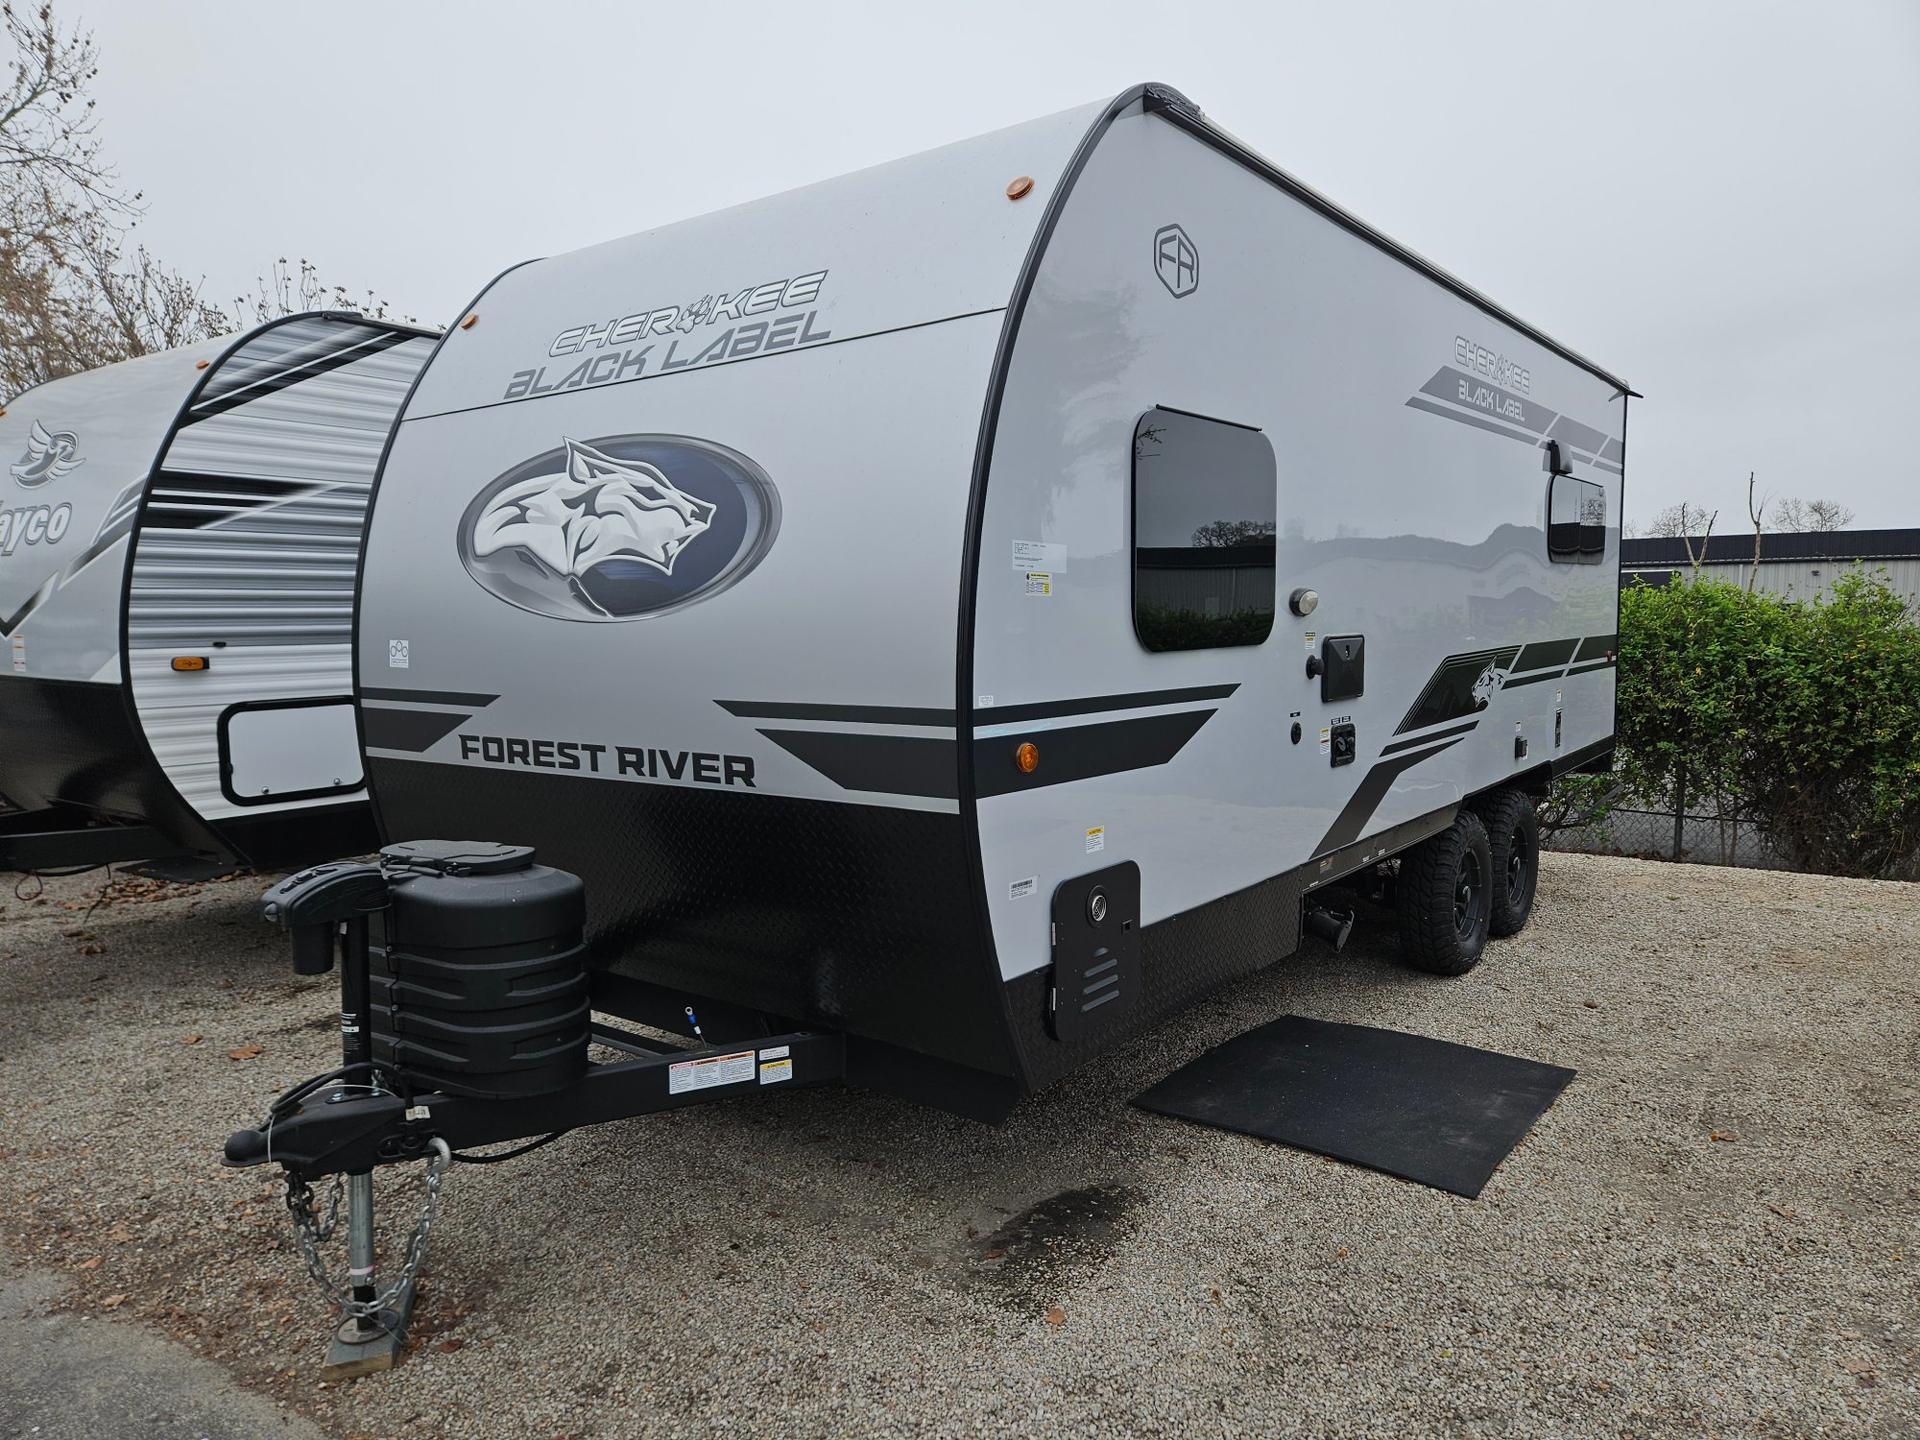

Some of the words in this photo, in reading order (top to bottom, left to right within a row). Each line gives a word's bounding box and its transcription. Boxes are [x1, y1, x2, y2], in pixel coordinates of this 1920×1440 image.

[503, 345, 655, 400] BLACK
[660, 310, 832, 371] LABEL
[1458, 379, 1495, 410] BLACK
[1496, 394, 1526, 422] LABEL
[0, 501, 73, 556] ayco
[458, 734, 606, 772] FOREST
[615, 745, 757, 787] RIVER
